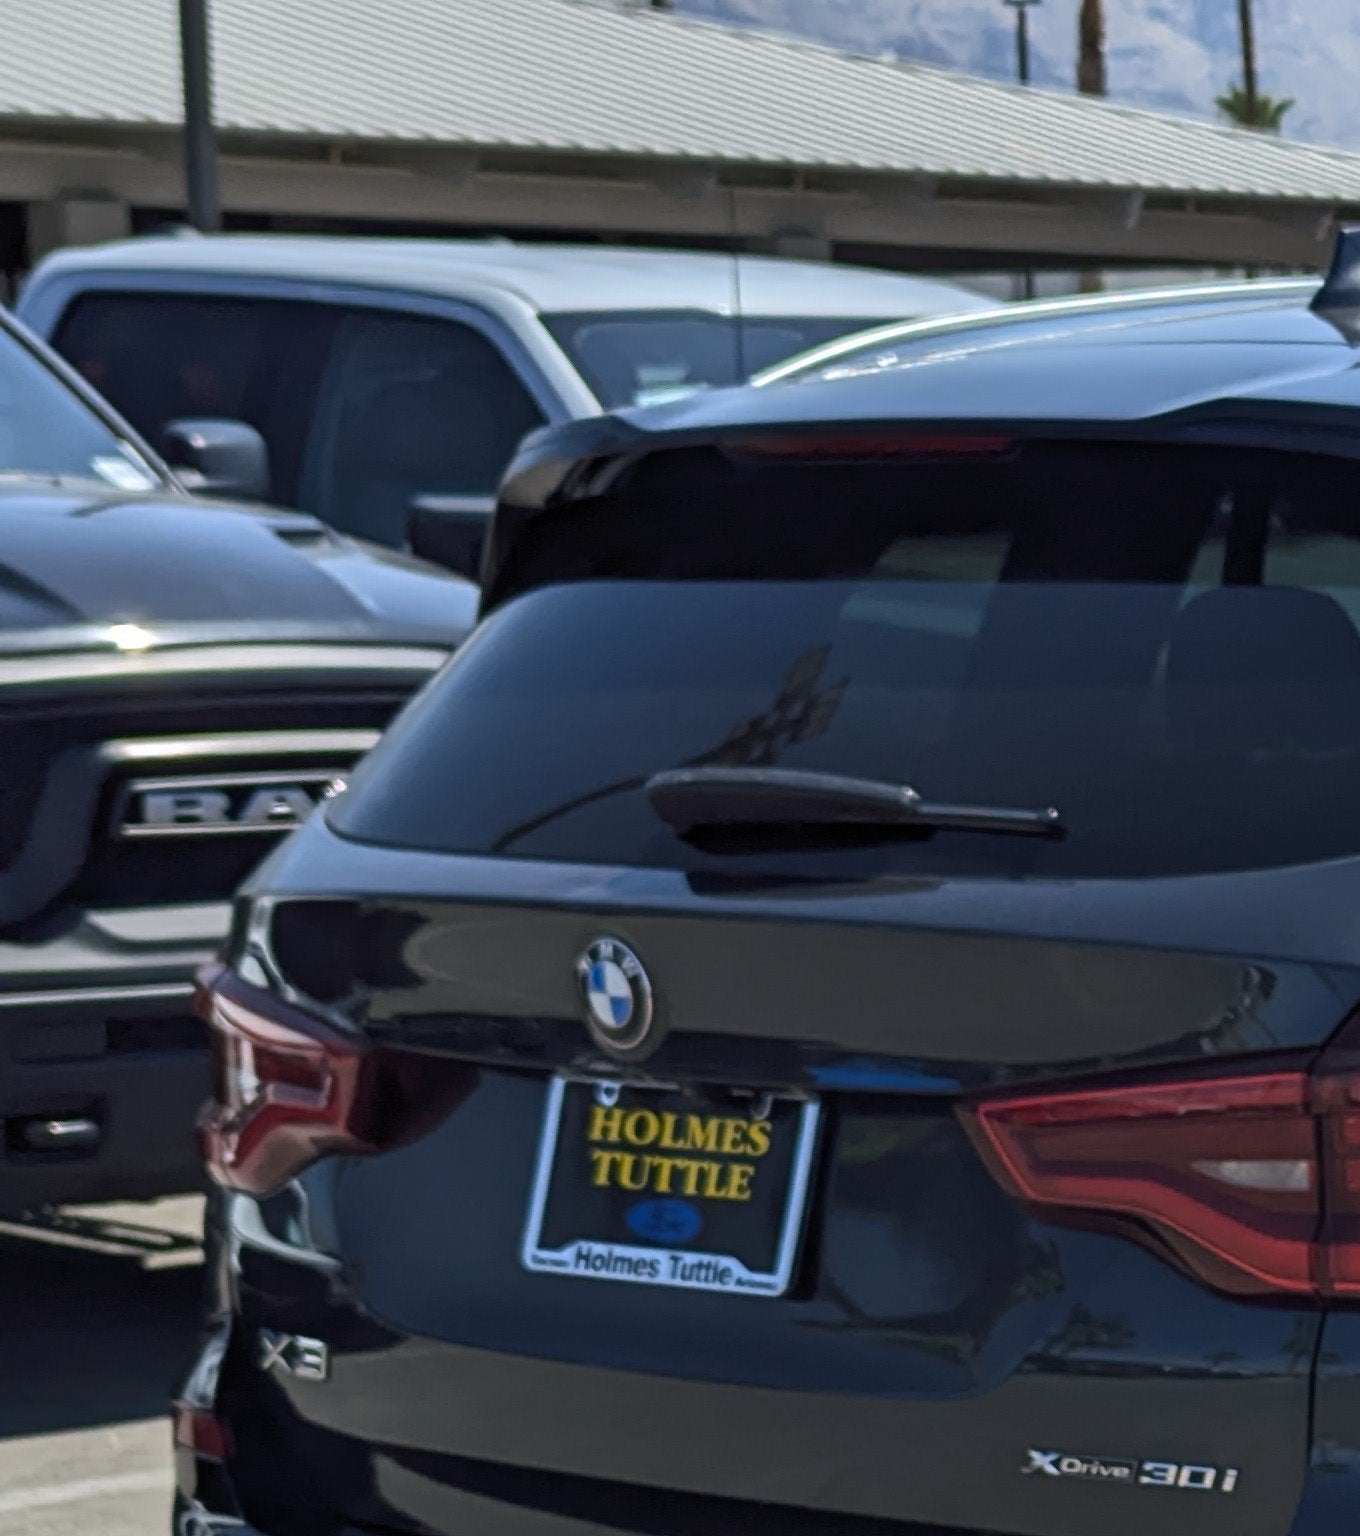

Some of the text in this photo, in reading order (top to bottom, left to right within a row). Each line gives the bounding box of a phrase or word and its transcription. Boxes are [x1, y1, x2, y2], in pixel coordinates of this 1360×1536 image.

[144, 786, 324, 823] RA
[588, 1106, 772, 1157] HOLMES
[590, 1150, 755, 1200] TUTTLE
[574, 1246, 660, 1279] Holmes
[670, 1255, 733, 1285] Tuttle
[258, 1330, 327, 1381] X3
